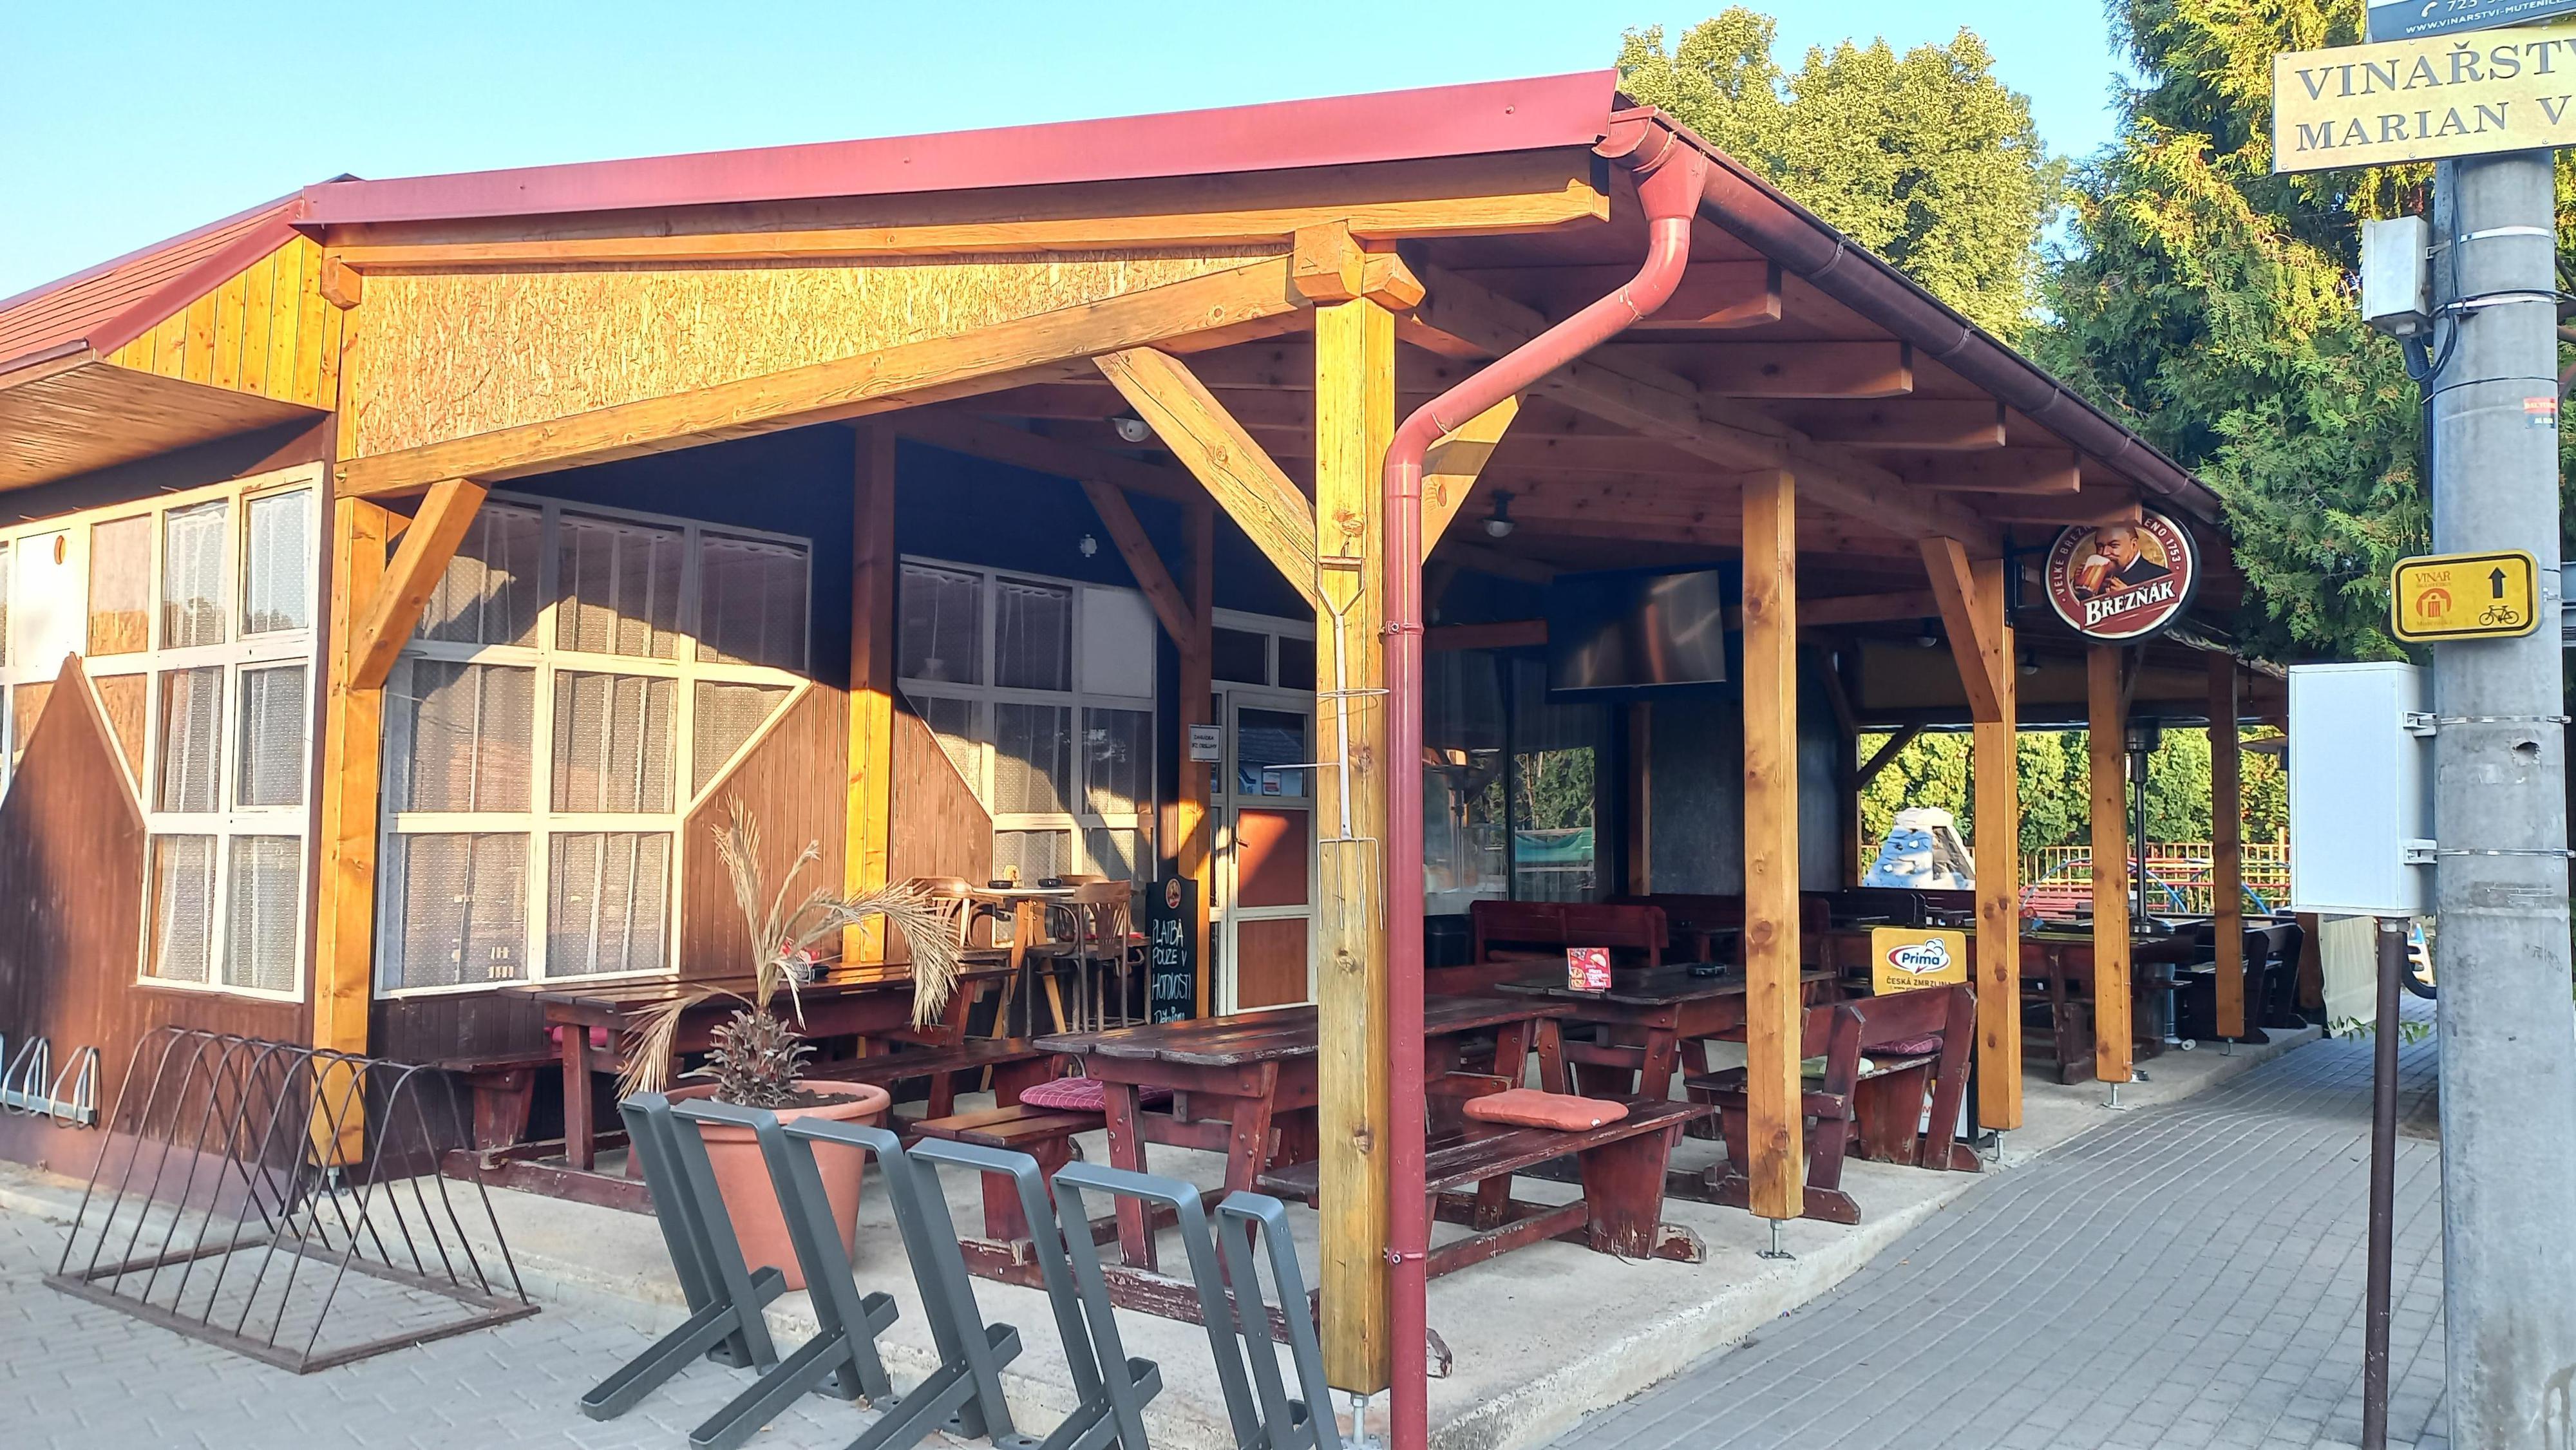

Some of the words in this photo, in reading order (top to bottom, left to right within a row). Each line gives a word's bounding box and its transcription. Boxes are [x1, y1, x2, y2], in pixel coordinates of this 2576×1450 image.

[2295, 102, 2510, 152] MARIAN
[2166, 538, 2181, 562] 1753
[2084, 580, 2175, 626] BŘEZŇÁK
[1152, 946, 1178, 968] POUZE
[1902, 952, 1940, 965] Prima
[1886, 976, 1911, 985] ČESKÁ
